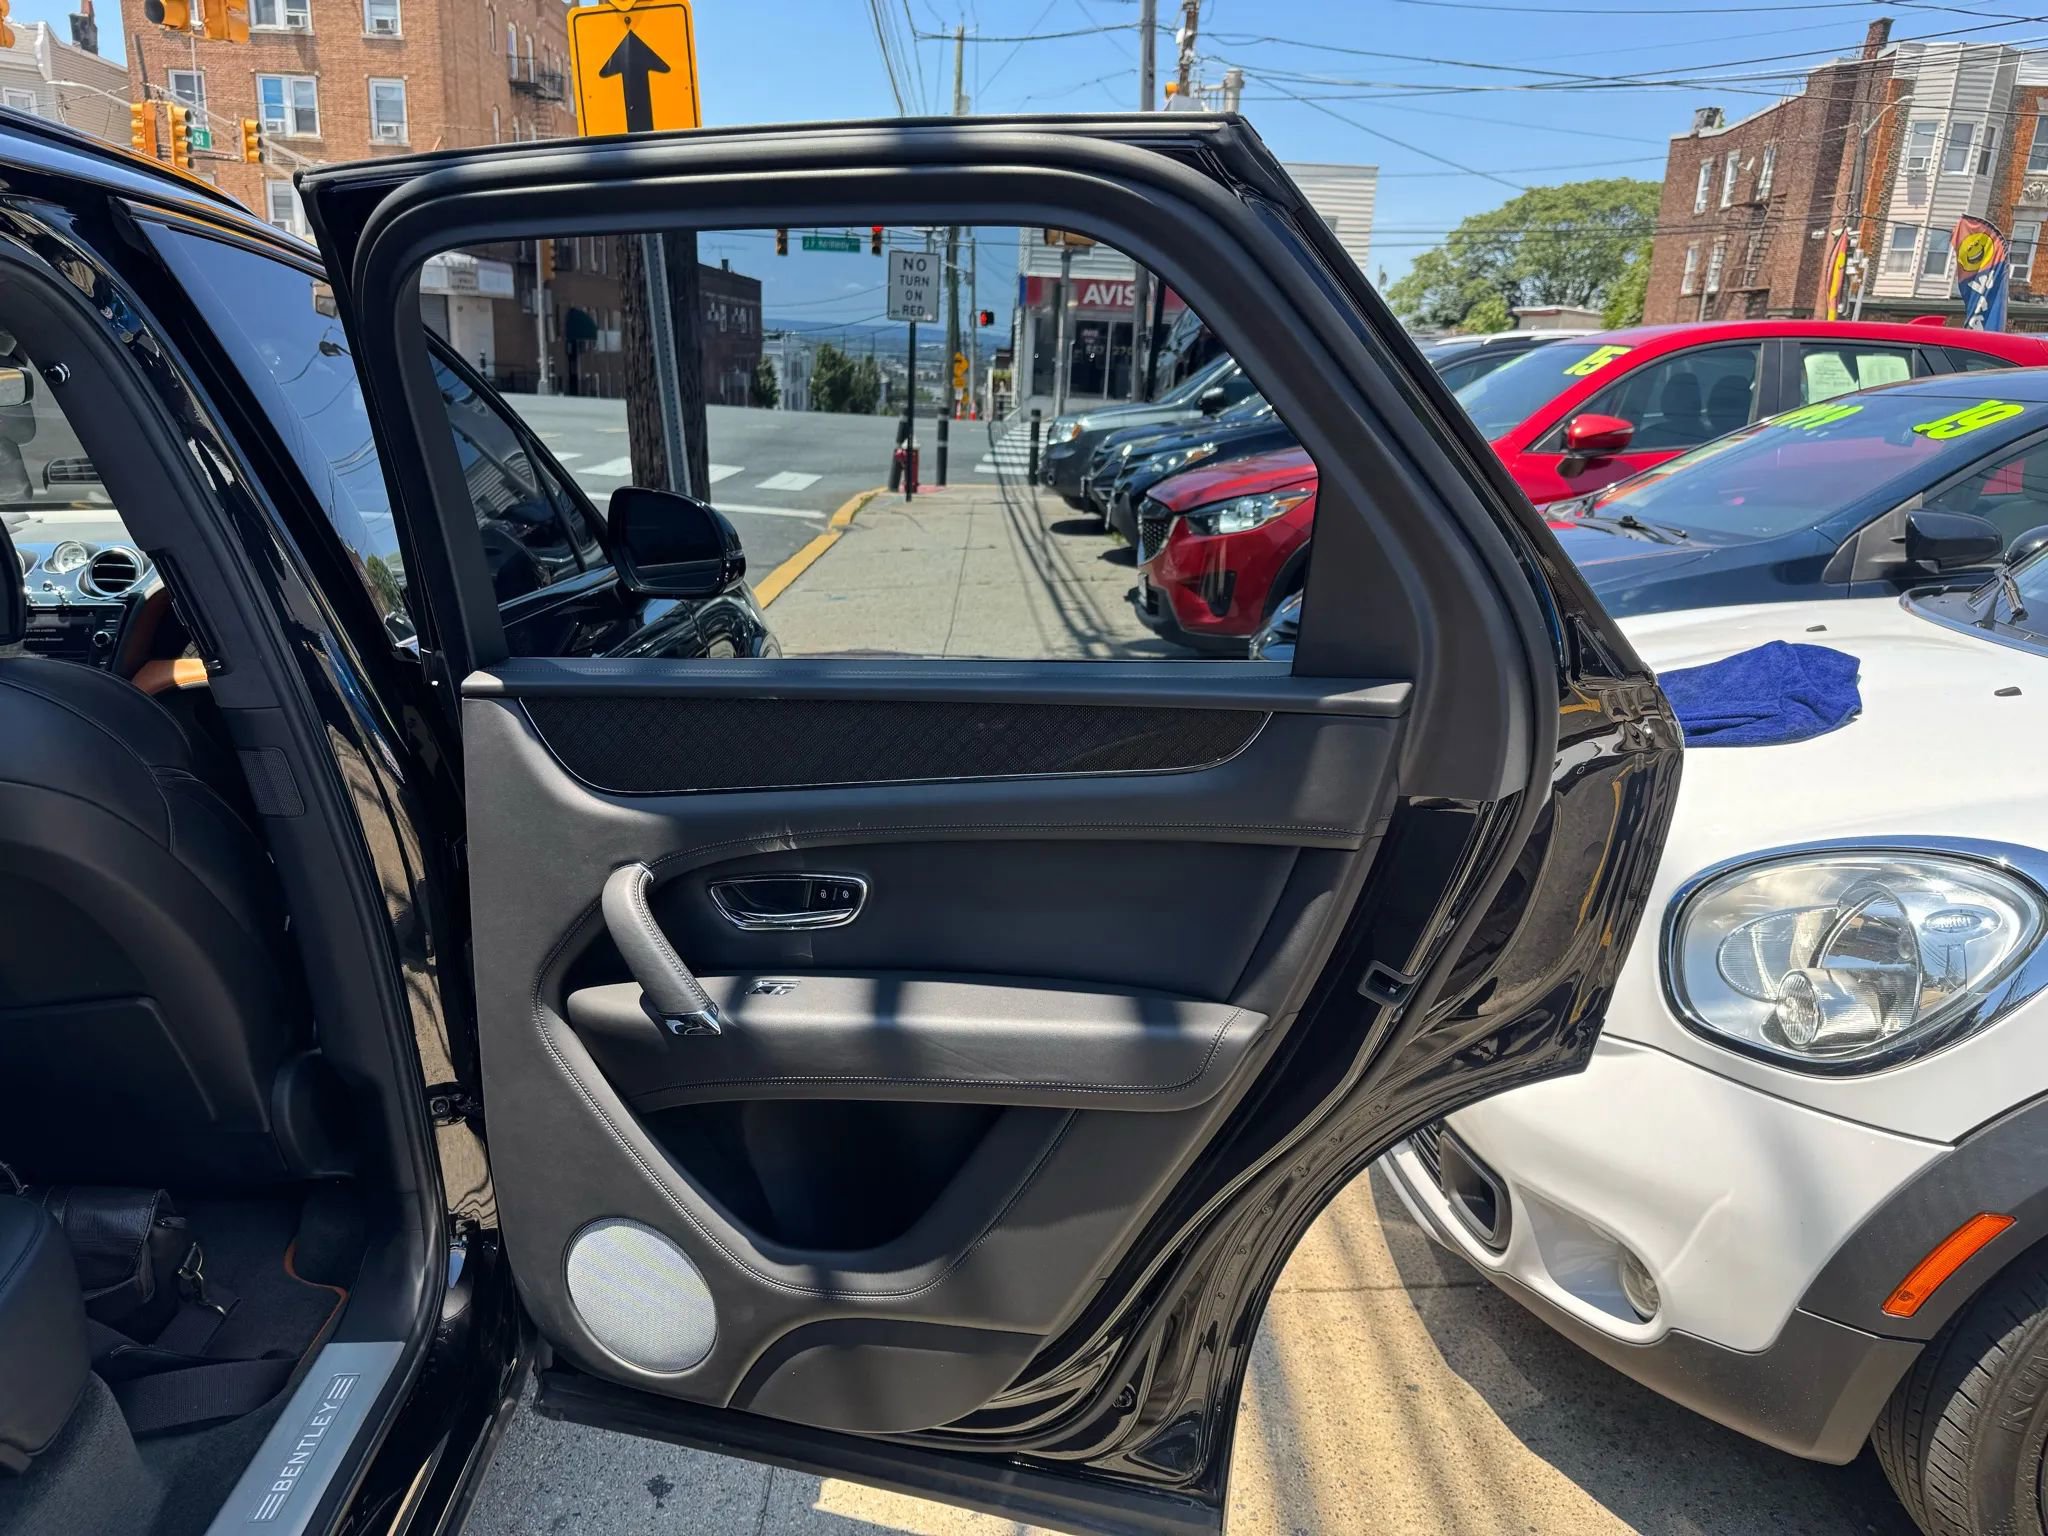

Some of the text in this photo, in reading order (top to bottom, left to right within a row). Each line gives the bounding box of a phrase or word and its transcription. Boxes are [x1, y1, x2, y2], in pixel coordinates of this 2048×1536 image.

[903, 257, 927, 272] NO
[900, 274, 929, 287] TURN
[905, 290, 922, 301] ON
[1082, 283, 1136, 307] AVIS
[902, 305, 925, 316] RED
[1562, 345, 1633, 376] 15
[1911, 399, 2025, 440] 19
[271, 1402, 338, 1492] BENTLEY
